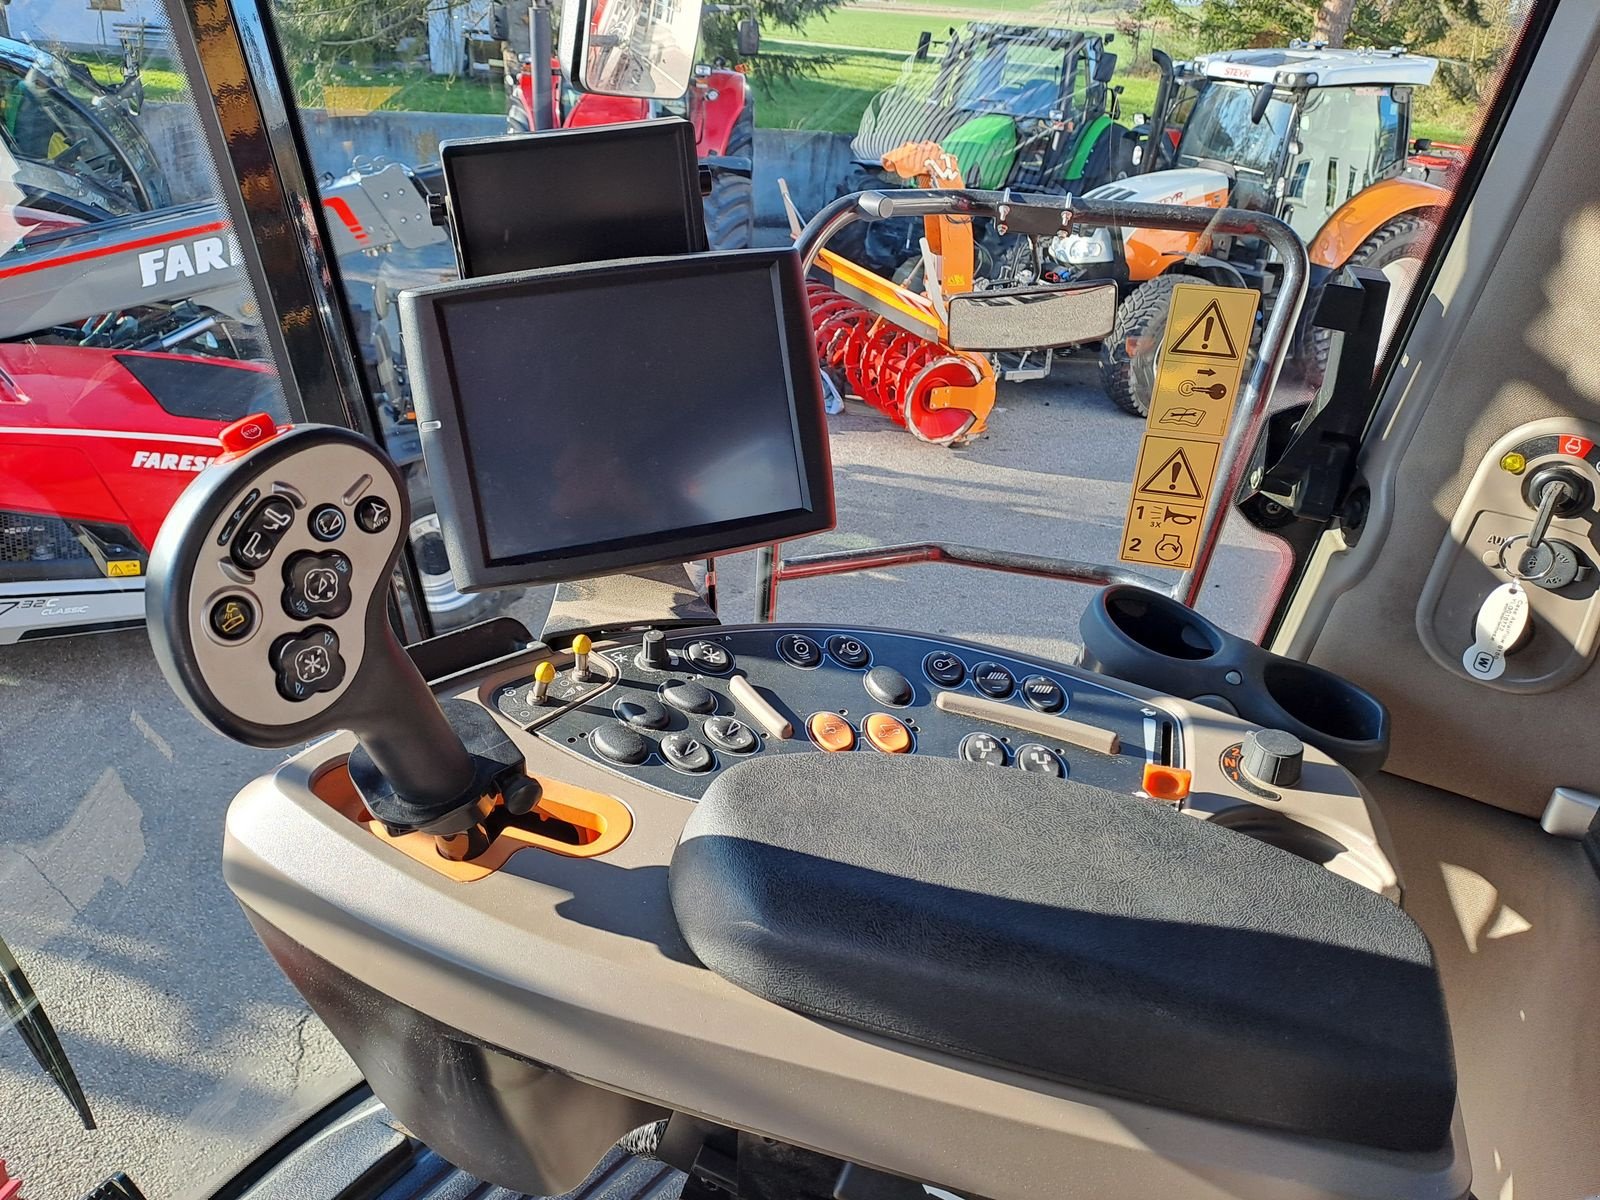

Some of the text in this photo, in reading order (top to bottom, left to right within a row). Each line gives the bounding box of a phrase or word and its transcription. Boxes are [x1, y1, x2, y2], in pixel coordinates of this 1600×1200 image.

[1224, 67, 1251, 77] STEYR
[1136, 505, 1145, 520] 1
[373, 516, 389, 529] AUTO
[1128, 537, 1142, 552] 2
[41, 606, 89, 616] CLASSIC
